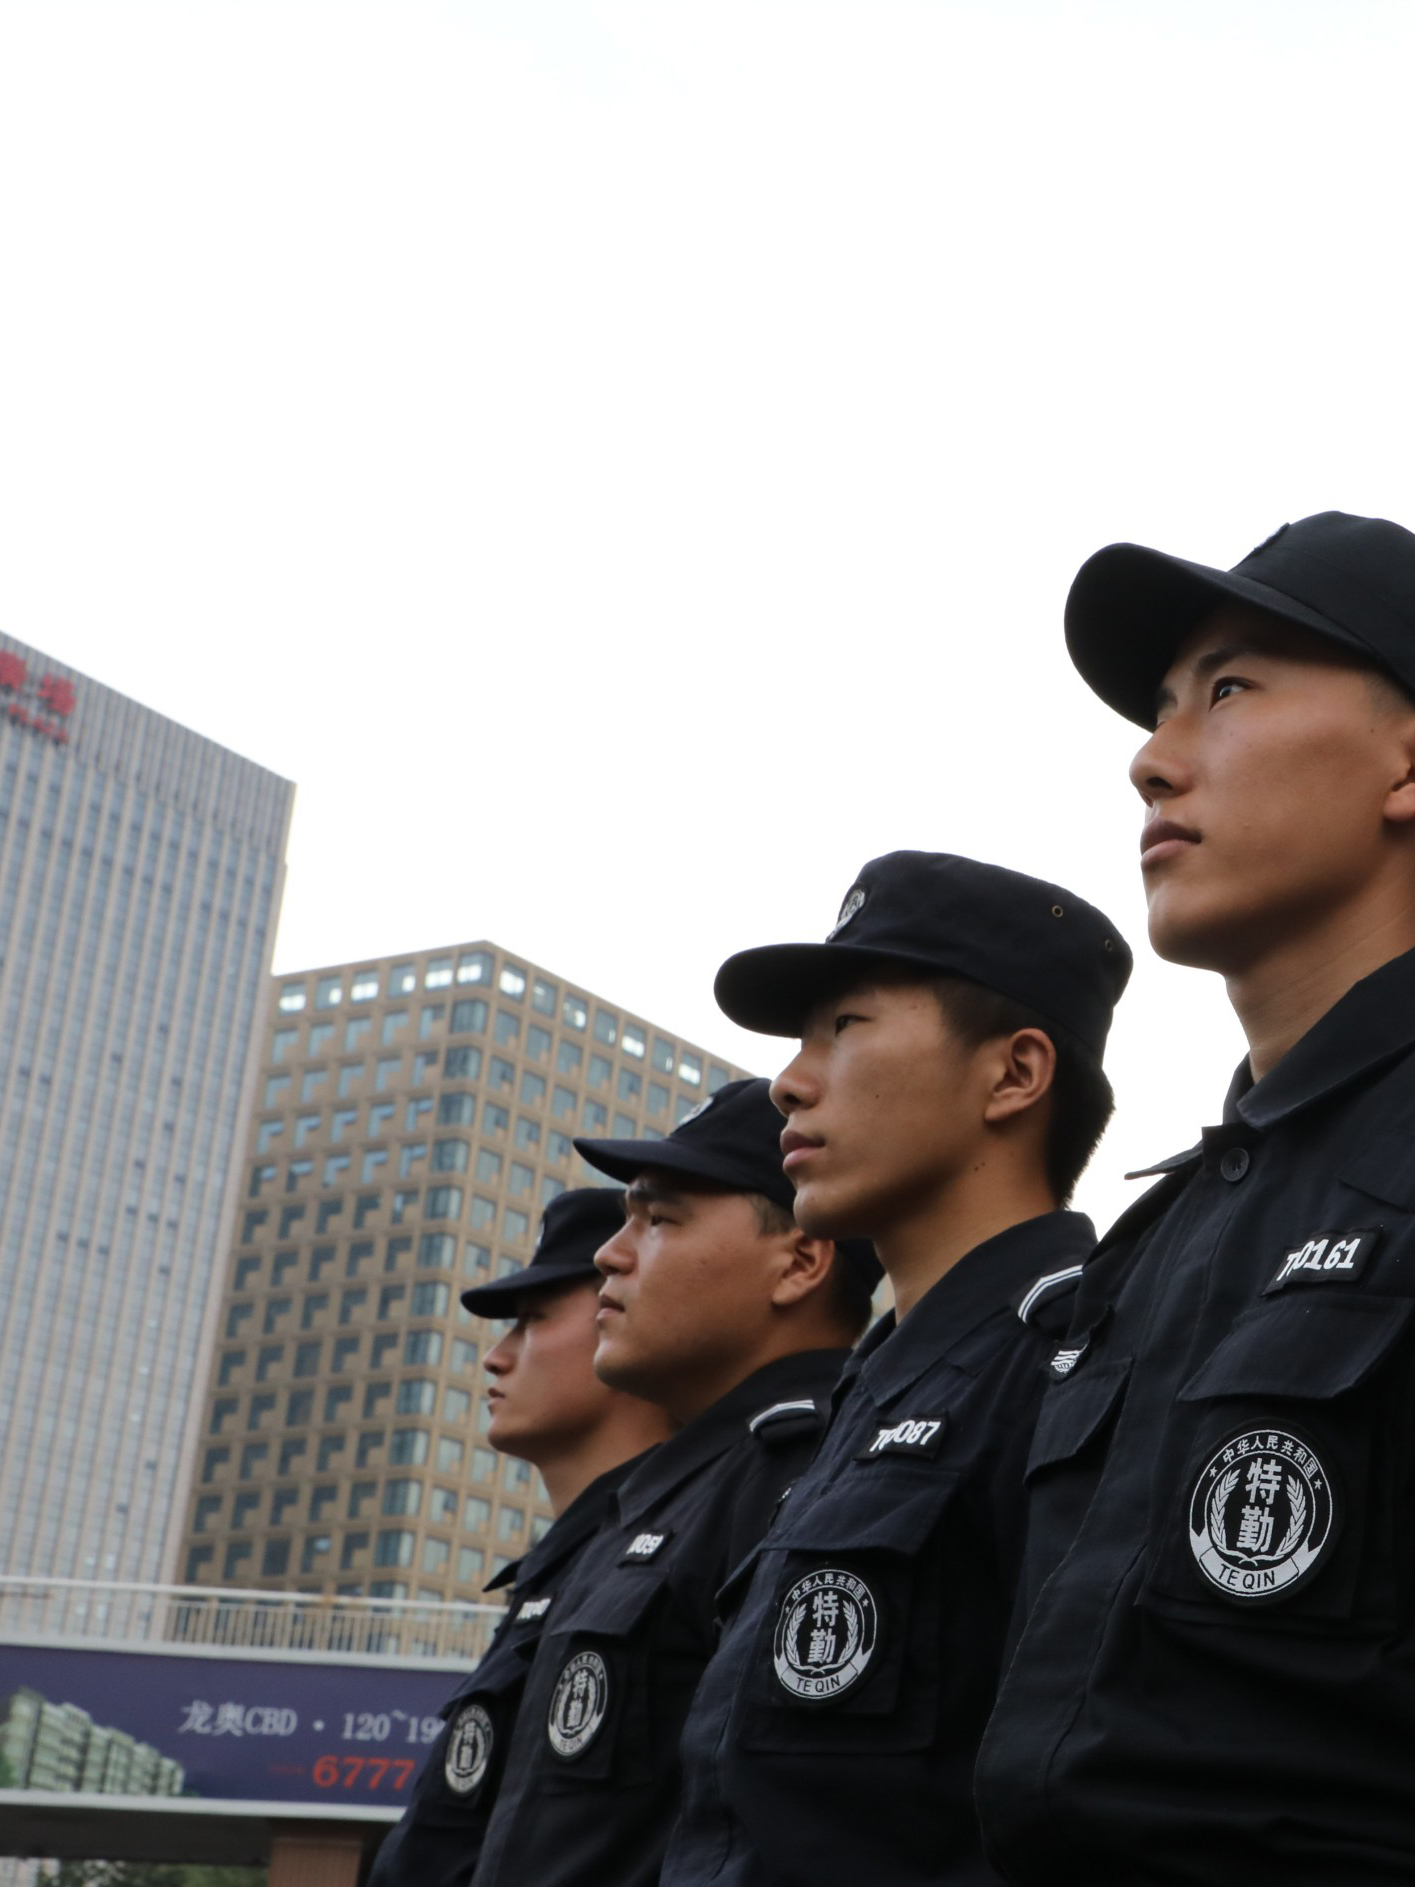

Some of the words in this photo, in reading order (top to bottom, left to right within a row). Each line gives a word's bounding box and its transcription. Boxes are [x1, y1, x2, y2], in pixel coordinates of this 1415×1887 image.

[1222, 1435, 1318, 1479] 中华人民共和国
[1236, 1457, 1282, 1553] 特勤
[791, 1573, 866, 1601] 中华人民共和国
[807, 1590, 839, 1664] 特勤
[178, 1700, 297, 1737] 龙奥CBD
[312, 1755, 415, 1791] 6777
